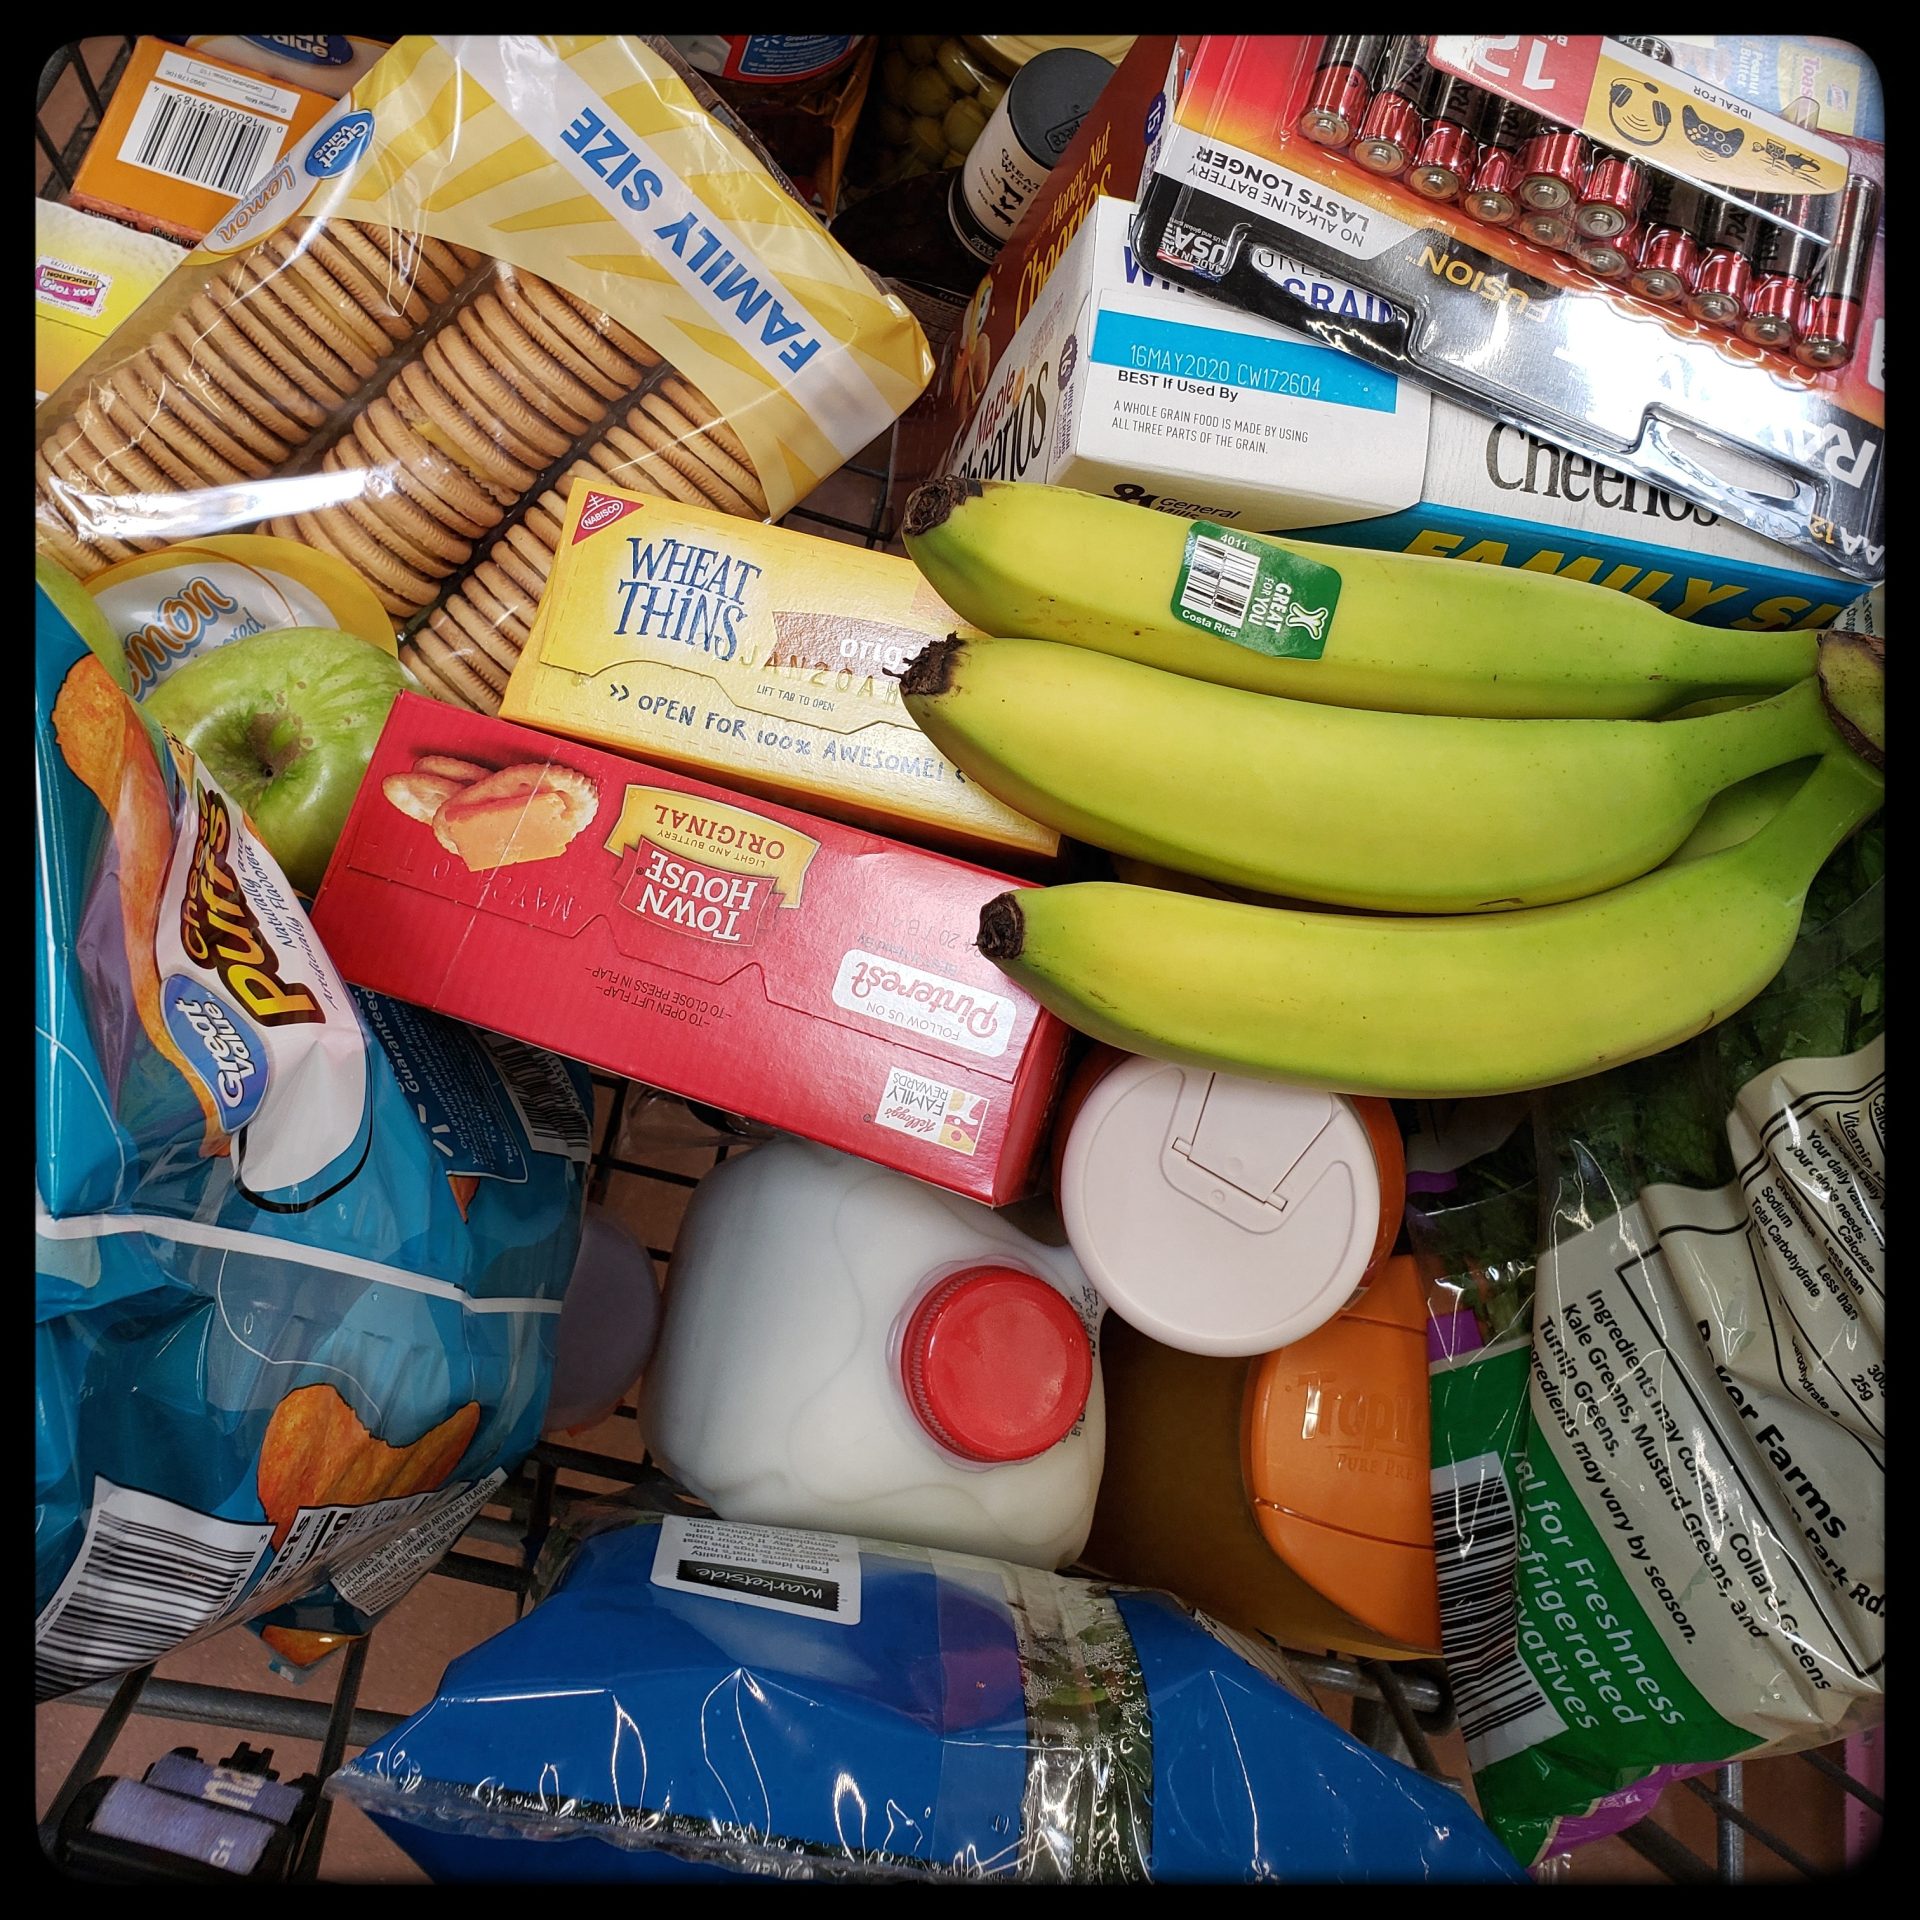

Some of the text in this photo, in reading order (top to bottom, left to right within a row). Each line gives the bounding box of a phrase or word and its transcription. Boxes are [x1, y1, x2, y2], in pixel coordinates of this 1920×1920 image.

[1736, 46, 1750, 89] Butter
[1749, 47, 1763, 96] Peanut
[1693, 84, 1753, 120] IDEAL FOR
[313, 125, 347, 159] Value
[317, 120, 369, 169] Great
[560, 107, 663, 211] SIZE
[1001, 148, 1041, 191] GREAT
[1051, 162, 1087, 233] Honey
[1086, 120, 1111, 182] Nut
[1187, 161, 1260, 201] BATTERY
[1198, 144, 1295, 197] LONGER
[220, 164, 297, 243] Lemon
[1260, 193, 1336, 235] ALKALINE
[1297, 189, 1371, 233] LASTS
[1173, 226, 1232, 270] USA
[1339, 228, 1366, 248] NO
[46, 270, 93, 286] EDUCATION
[73, 287, 97, 297] BOX
[653, 212, 822, 374] FAMILY
[1417, 245, 1554, 323] FUSION
[1117, 369, 1239, 403] BEST If Used By
[1130, 343, 1322, 399] 16MAY2020 CW172604
[975, 364, 1017, 452] Maple
[1113, 400, 1310, 444] A WHOLE GRAIN FOOD IS MADE BY USING
[1111, 416, 1269, 455] ALL THREE PARTS OF THE GRAIN.
[582, 502, 621, 528] NABISCO
[1159, 496, 1242, 521] General
[1808, 513, 1836, 545] 12
[1220, 533, 1248, 551] 4011
[625, 537, 763, 606] WHEAT
[1181, 609, 1238, 639] Costa Rica
[1247, 576, 1275, 627] FOR YOU
[1265, 582, 1293, 633] GREAT
[1731, 596, 1846, 632] SI
[839, 636, 913, 674] orig
[756, 684, 836, 713] LIFT TAB TO OPEN
[638, 693, 697, 727] OPEN
[704, 711, 748, 742] FOR
[756, 729, 812, 757] 100%
[653, 804, 787, 861] ORIGINAL
[656, 829, 767, 869] LIGHT AND BUTTERY
[182, 798, 210, 960] Cheese
[236, 828, 298, 950] Naturally and
[644, 849, 759, 911] HOUSE
[636, 883, 742, 942] TOWN
[292, 916, 340, 1011] Artificially
[620, 976, 709, 1014] CLOSE PRESS IN
[631, 994, 688, 1021] OPEN LIFT
[850, 961, 999, 1040] Pinterest
[202, 1000, 257, 1080] Value
[866, 1000, 961, 1042] FOLLOW US ON
[175, 998, 245, 1109] Great
[886, 1085, 948, 1118] FAMILY
[892, 1071, 950, 1101] REWARDS
[884, 1106, 937, 1134] Kellogg's
[1843, 1108, 1874, 1171] Vitamin
[1807, 1129, 1851, 1186] Your daily
[1786, 1143, 1814, 1169] your
[1836, 1201, 1867, 1245] needs:
[1751, 1196, 1823, 1299] Total Carbohydrate
[1761, 1185, 1860, 1323] Sodium Less than
[1838, 1224, 1877, 1276] Calories
[1843, 1267, 1866, 1298] than
[1534, 1317, 1628, 1458] Turnip Greens.
[1849, 1373, 1875, 1402] 25g
[1561, 1303, 1768, 1645] Kale Greens, Mustard Greens, and
[1583, 1288, 1662, 1402] Ingredients
[1647, 1397, 1686, 1447] may
[1725, 1528, 1786, 1614] Collard
[1755, 1423, 1848, 1541] Farms
[690, 1549, 731, 1561] quality
[760, 1558, 792, 1567] ideas
[1567, 1437, 1701, 1647] may vary by season.
[1804, 1526, 1850, 1590] Park
[795, 1563, 829, 1573] Fresh
[1491, 1506, 1646, 1737] efrigerated
[1524, 1490, 1686, 1735] for Freshness
